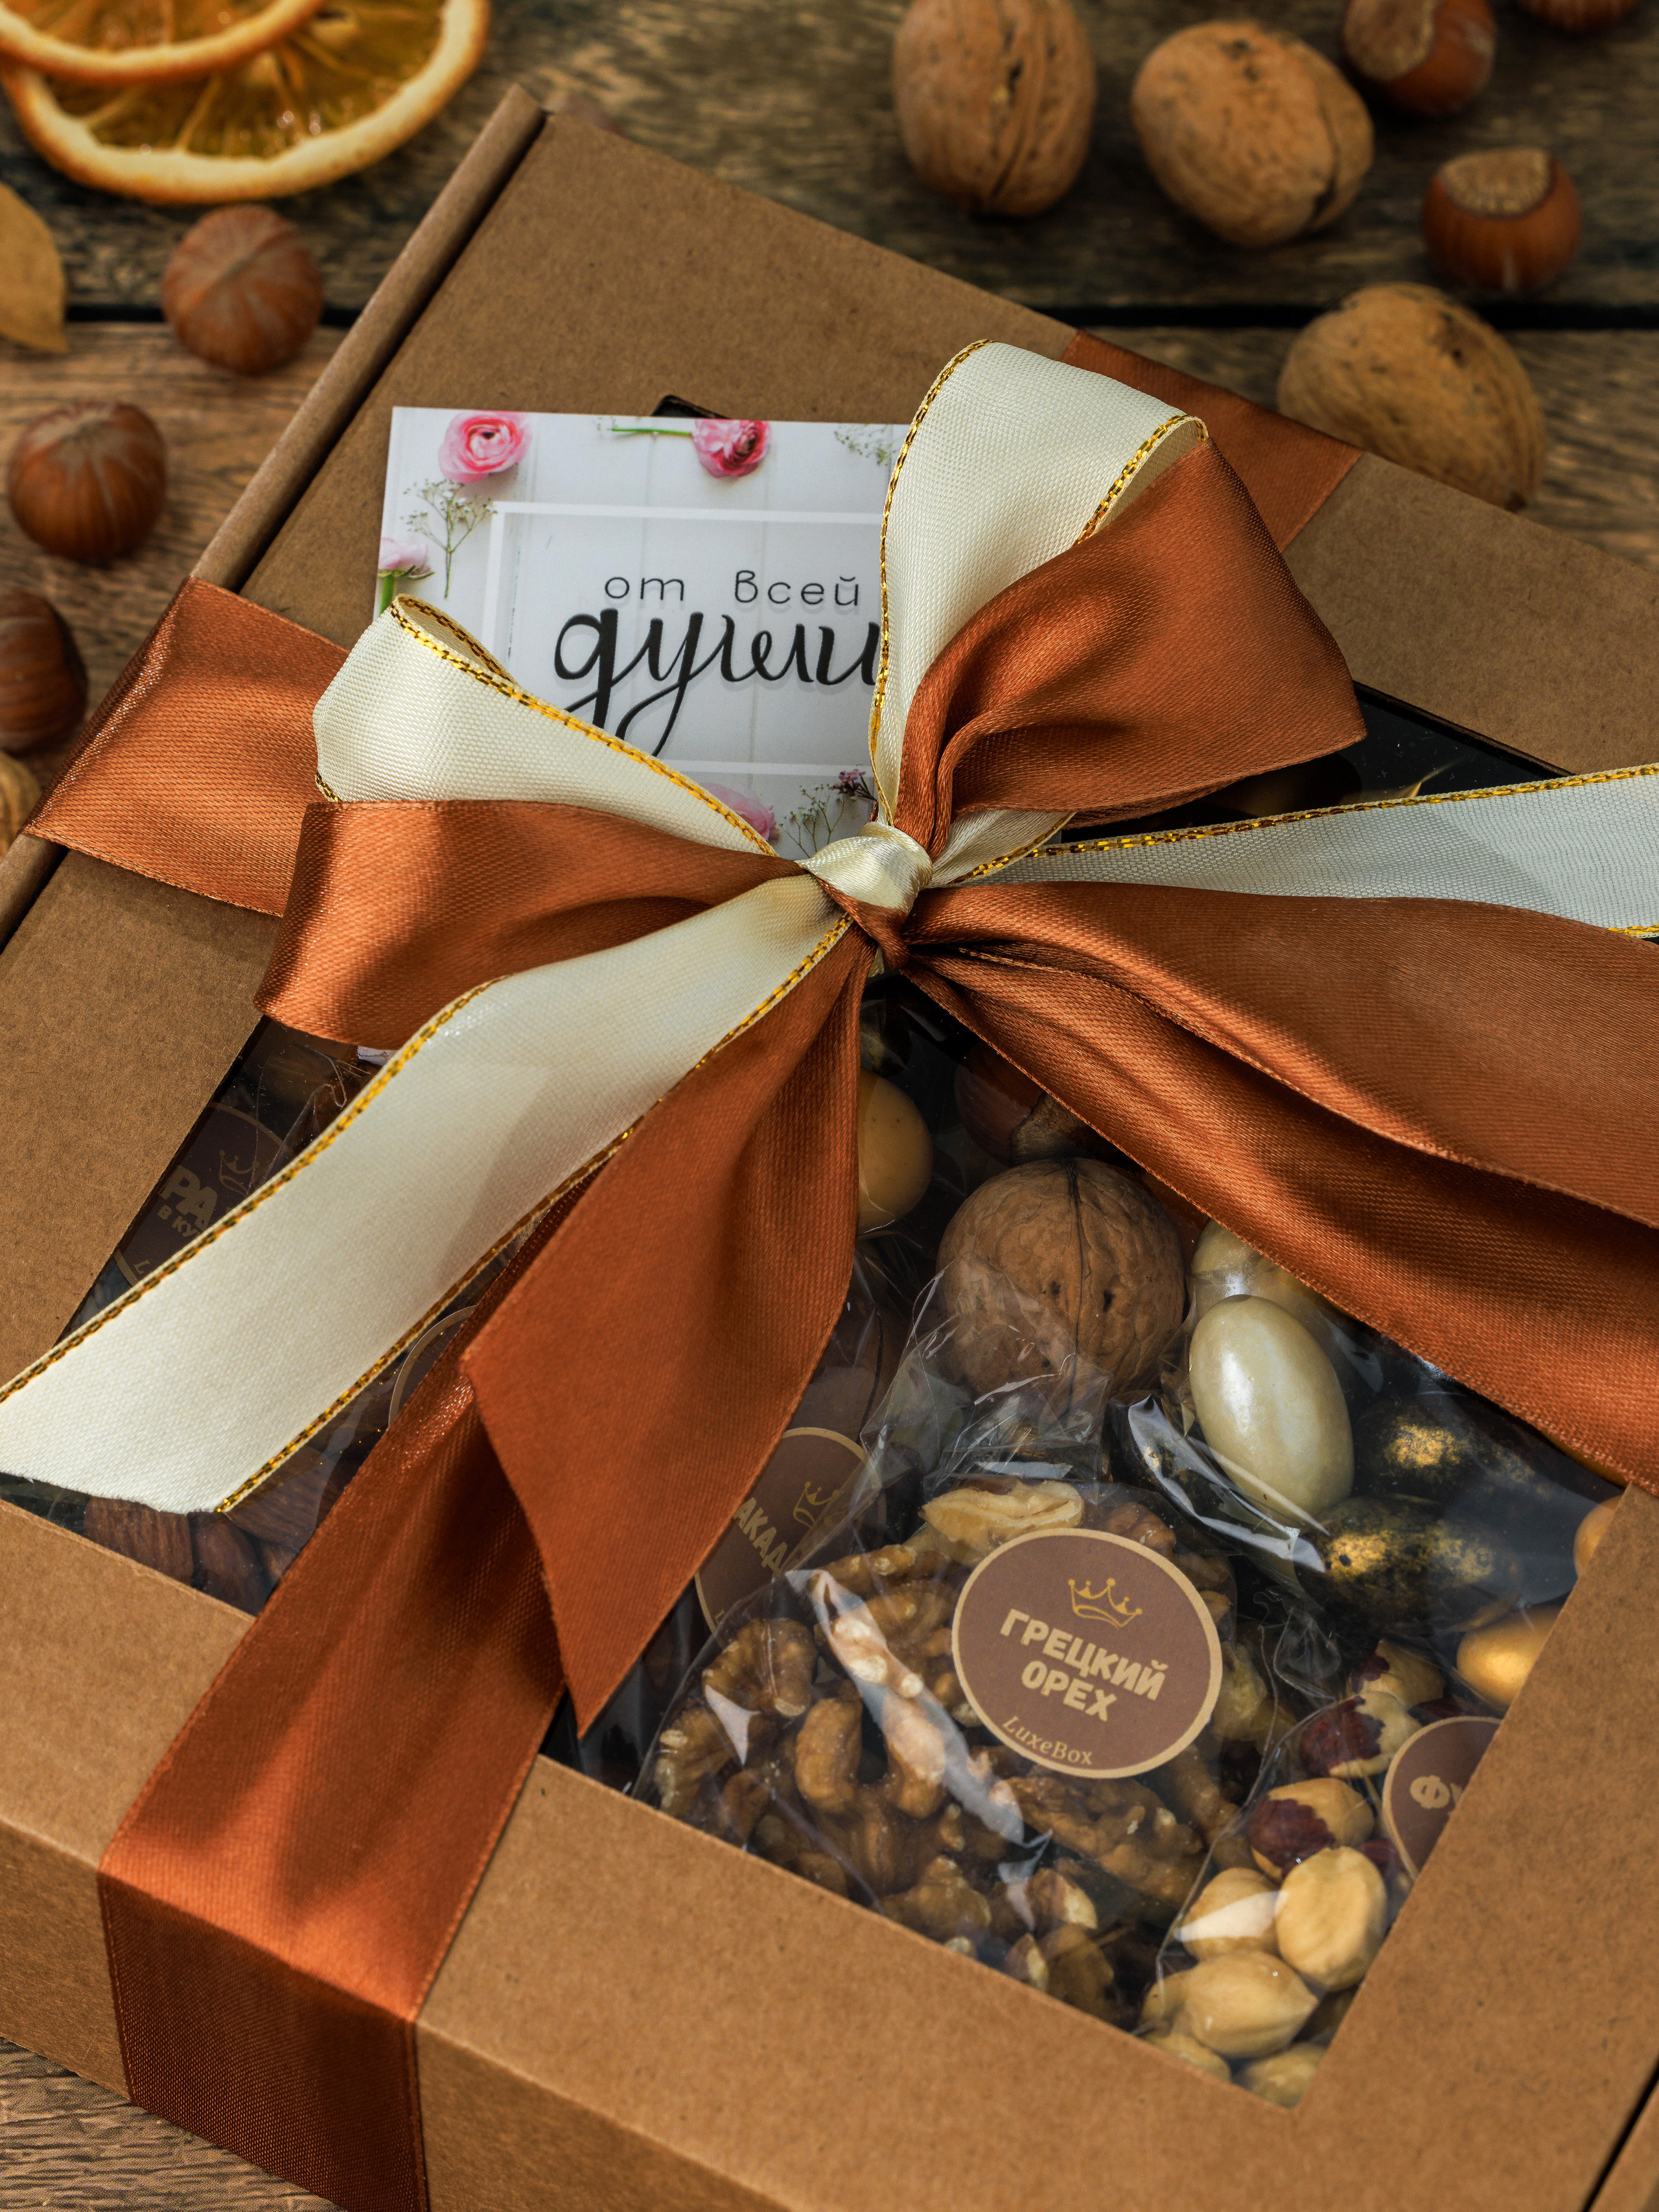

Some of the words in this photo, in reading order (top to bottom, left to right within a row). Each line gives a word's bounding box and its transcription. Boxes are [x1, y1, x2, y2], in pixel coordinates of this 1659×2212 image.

[604, 576, 685, 602] от
[999, 1608, 1169, 1701] ГРЕЦКИЙ
[1021, 1660, 1118, 1722] ОРЕХ
[1003, 1716, 1094, 1767] LuxeBox
